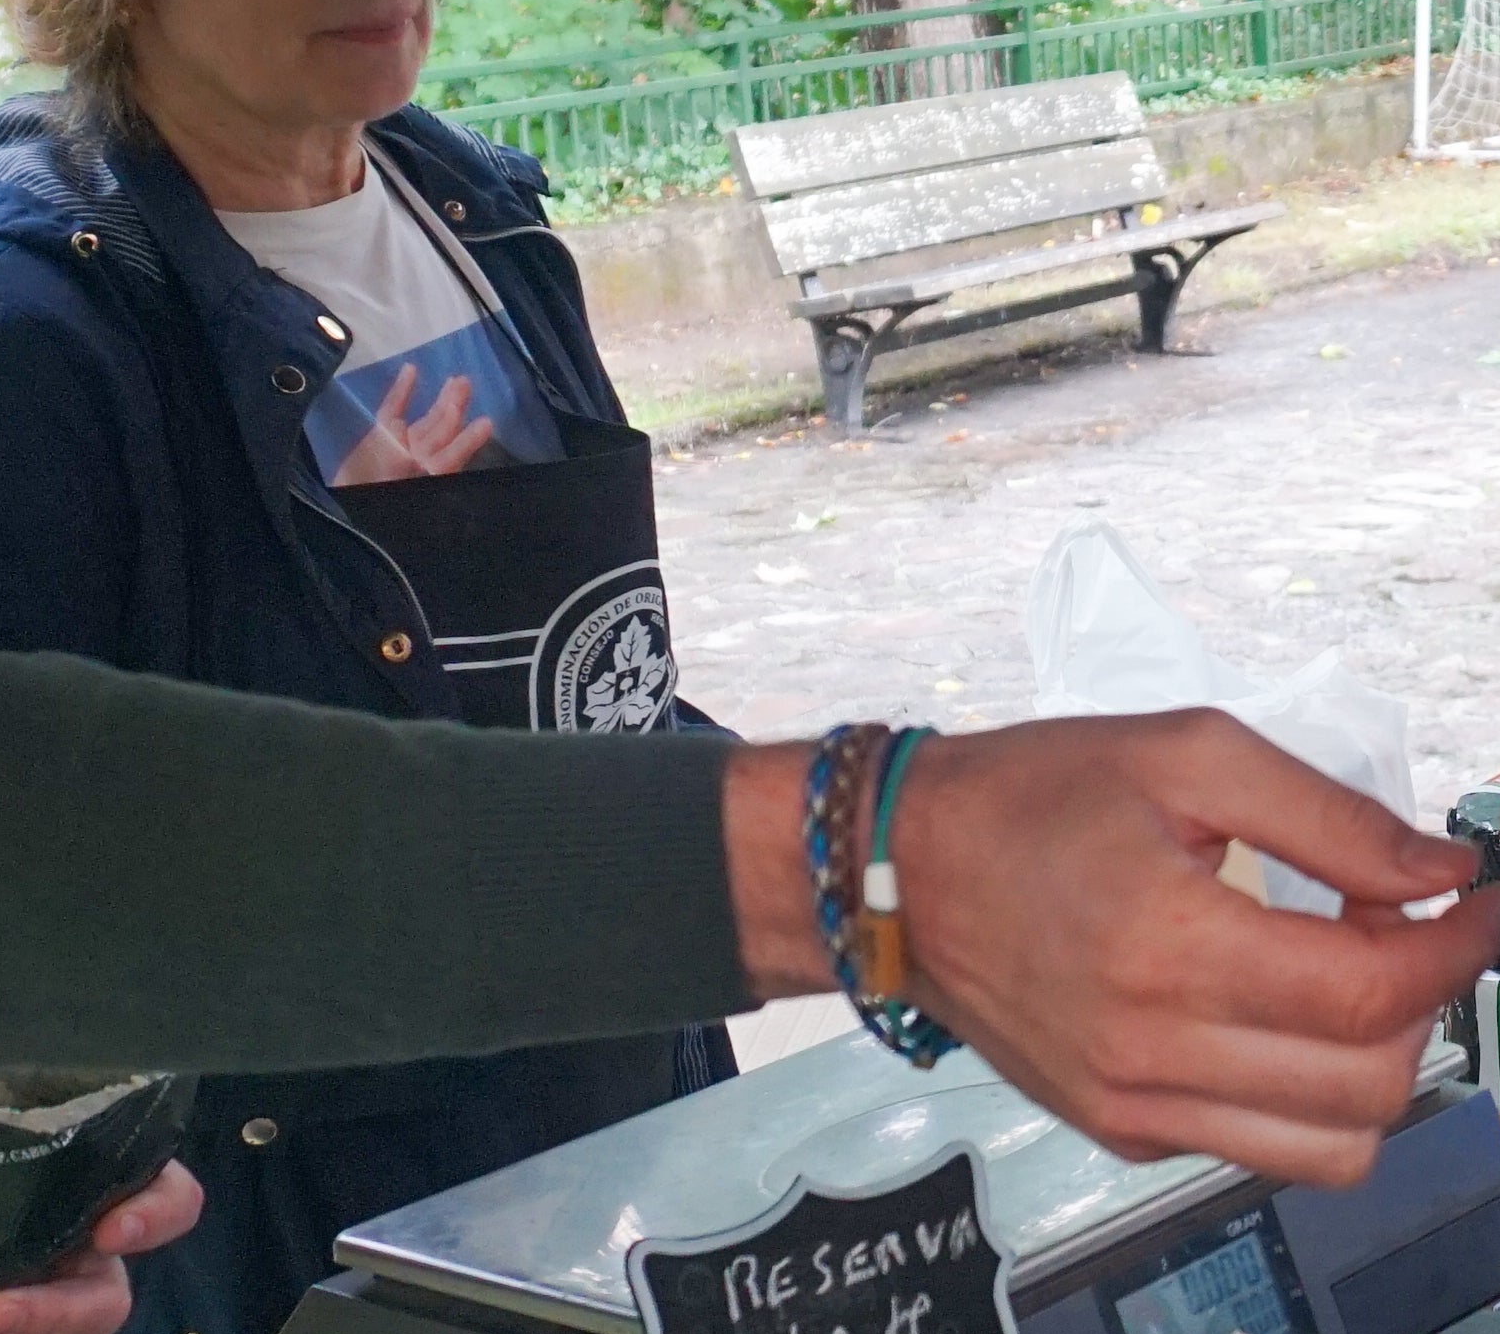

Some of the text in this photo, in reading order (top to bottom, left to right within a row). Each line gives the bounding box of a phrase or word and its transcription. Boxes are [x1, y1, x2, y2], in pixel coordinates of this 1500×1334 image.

[613, 597, 634, 616] DE
[579, 629, 615, 684] CONSEJO
[723, 1205, 979, 1324] RESERVA
